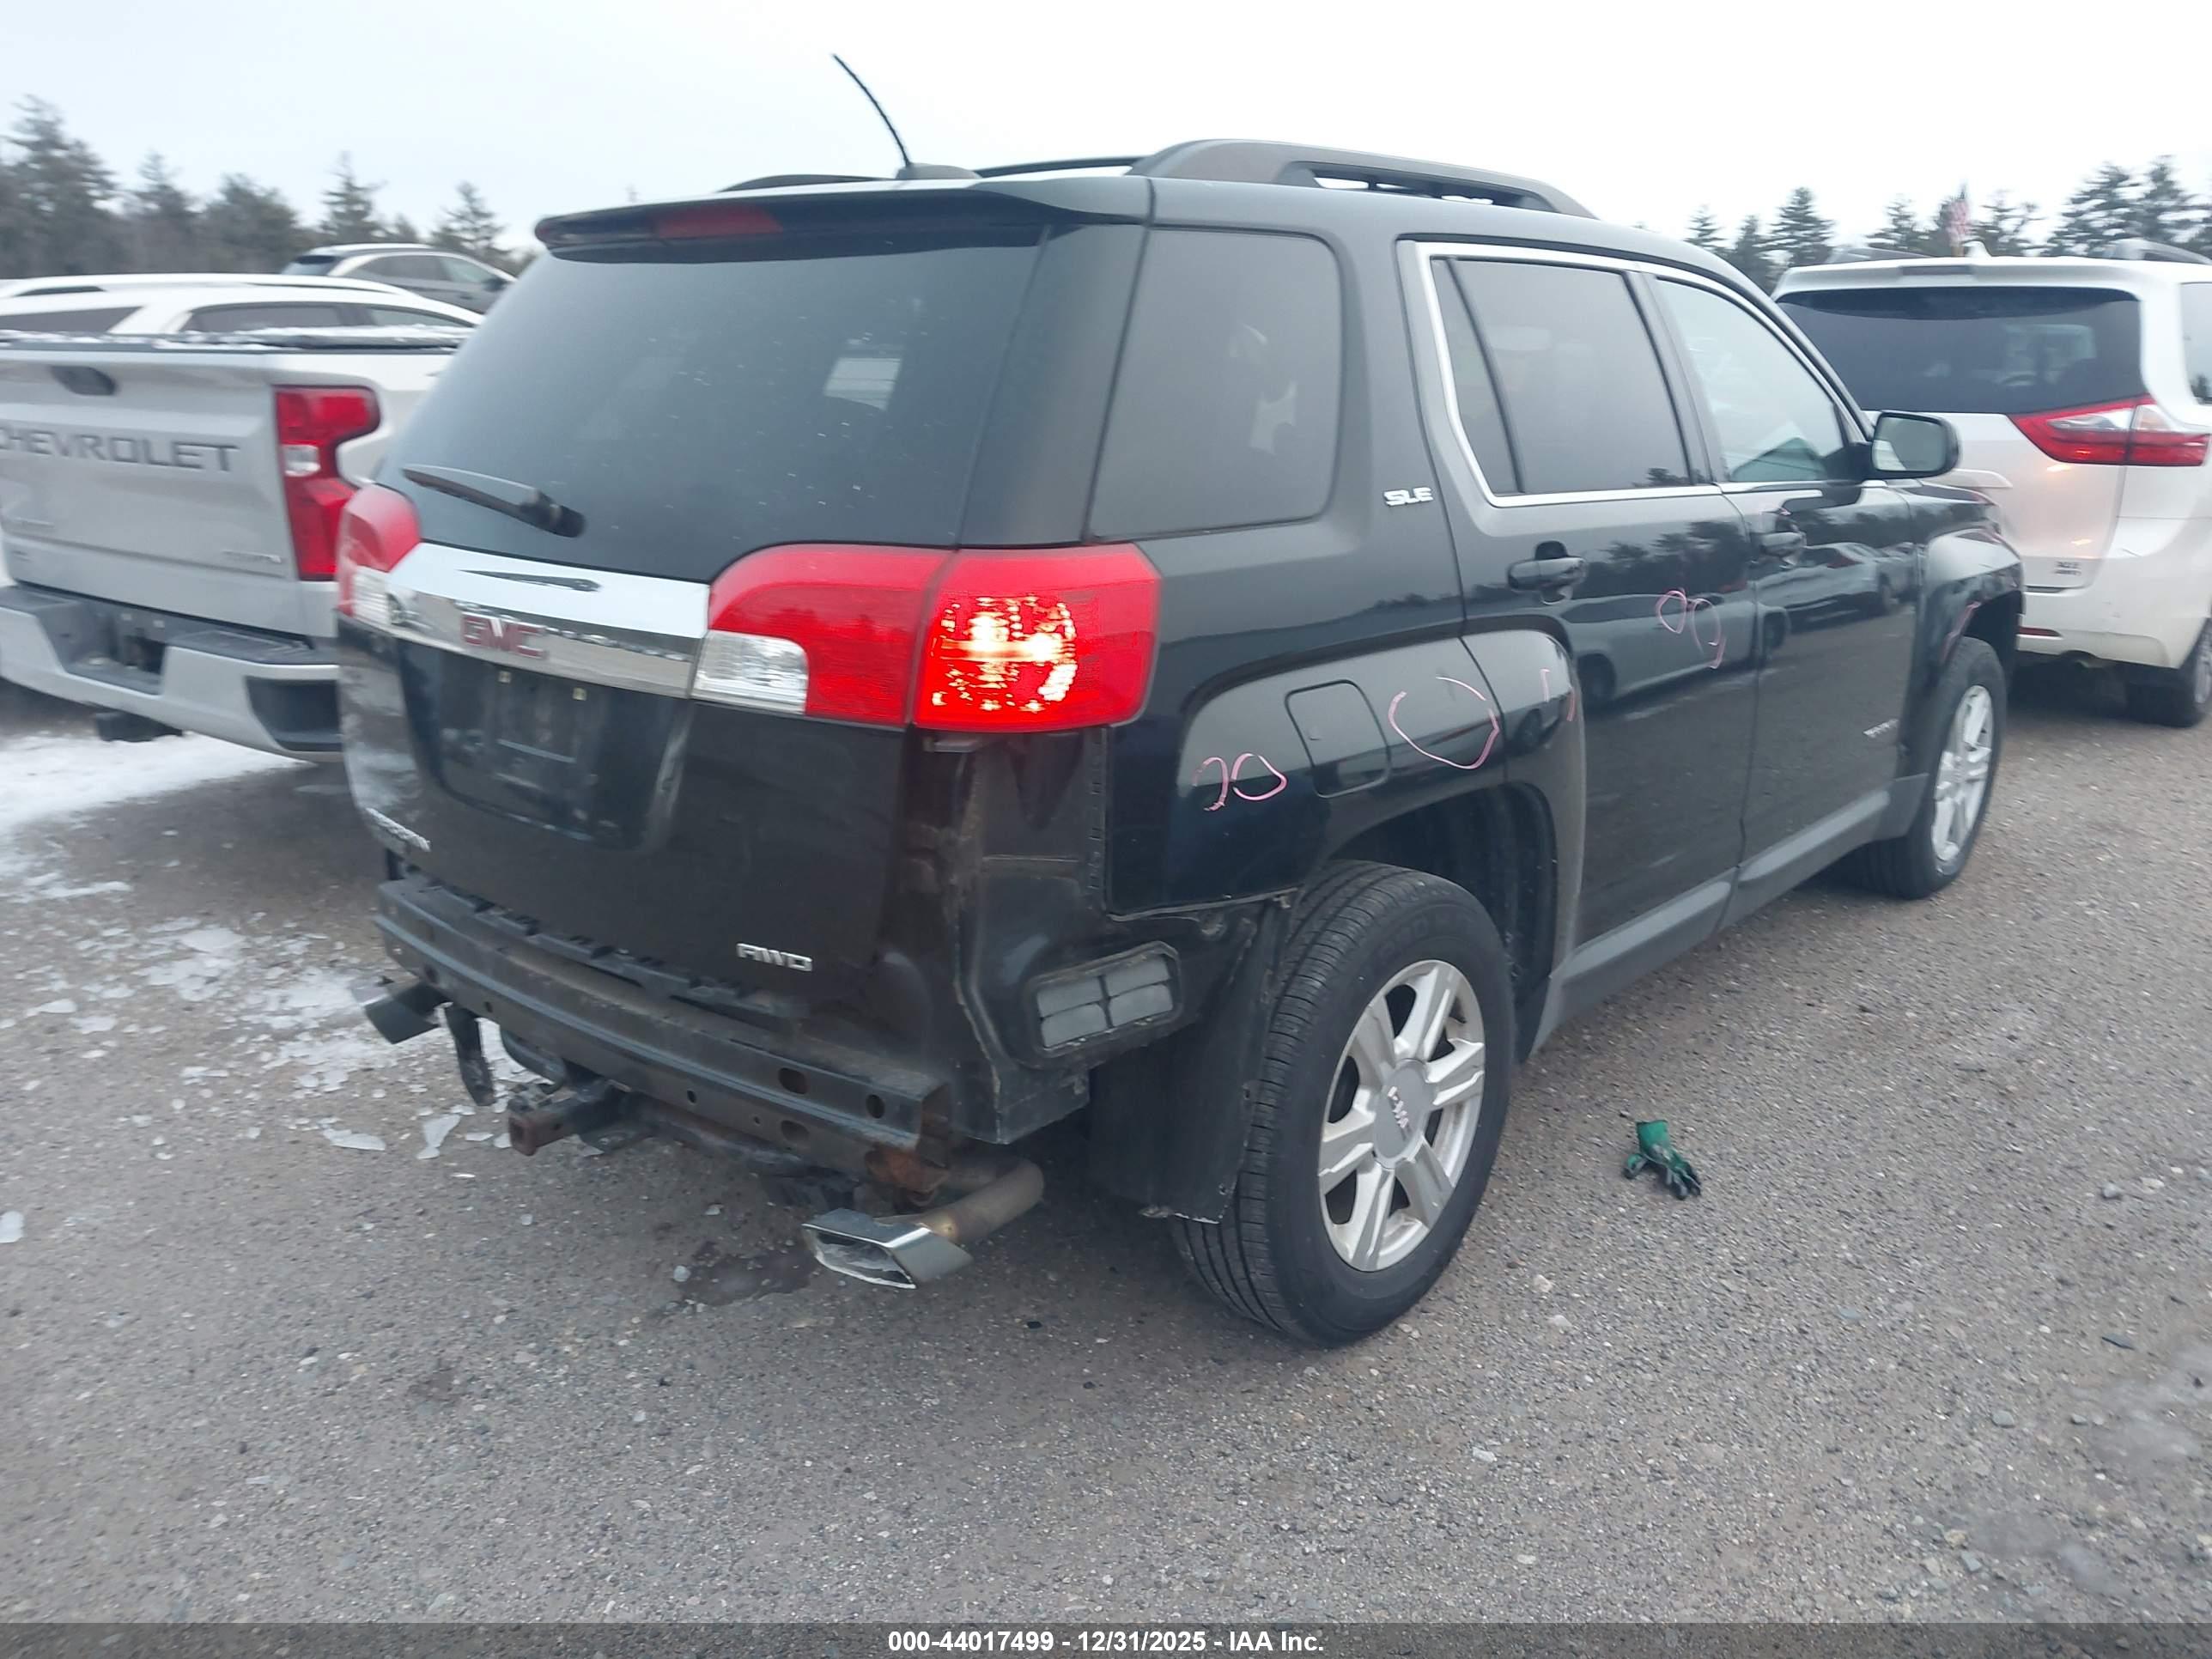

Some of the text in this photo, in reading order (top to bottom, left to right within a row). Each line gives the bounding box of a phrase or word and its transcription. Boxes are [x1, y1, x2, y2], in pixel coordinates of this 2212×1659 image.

[1383, 487, 1434, 506] SLE
[460, 611, 548, 660] GMC
[736, 943, 813, 972] AWD
